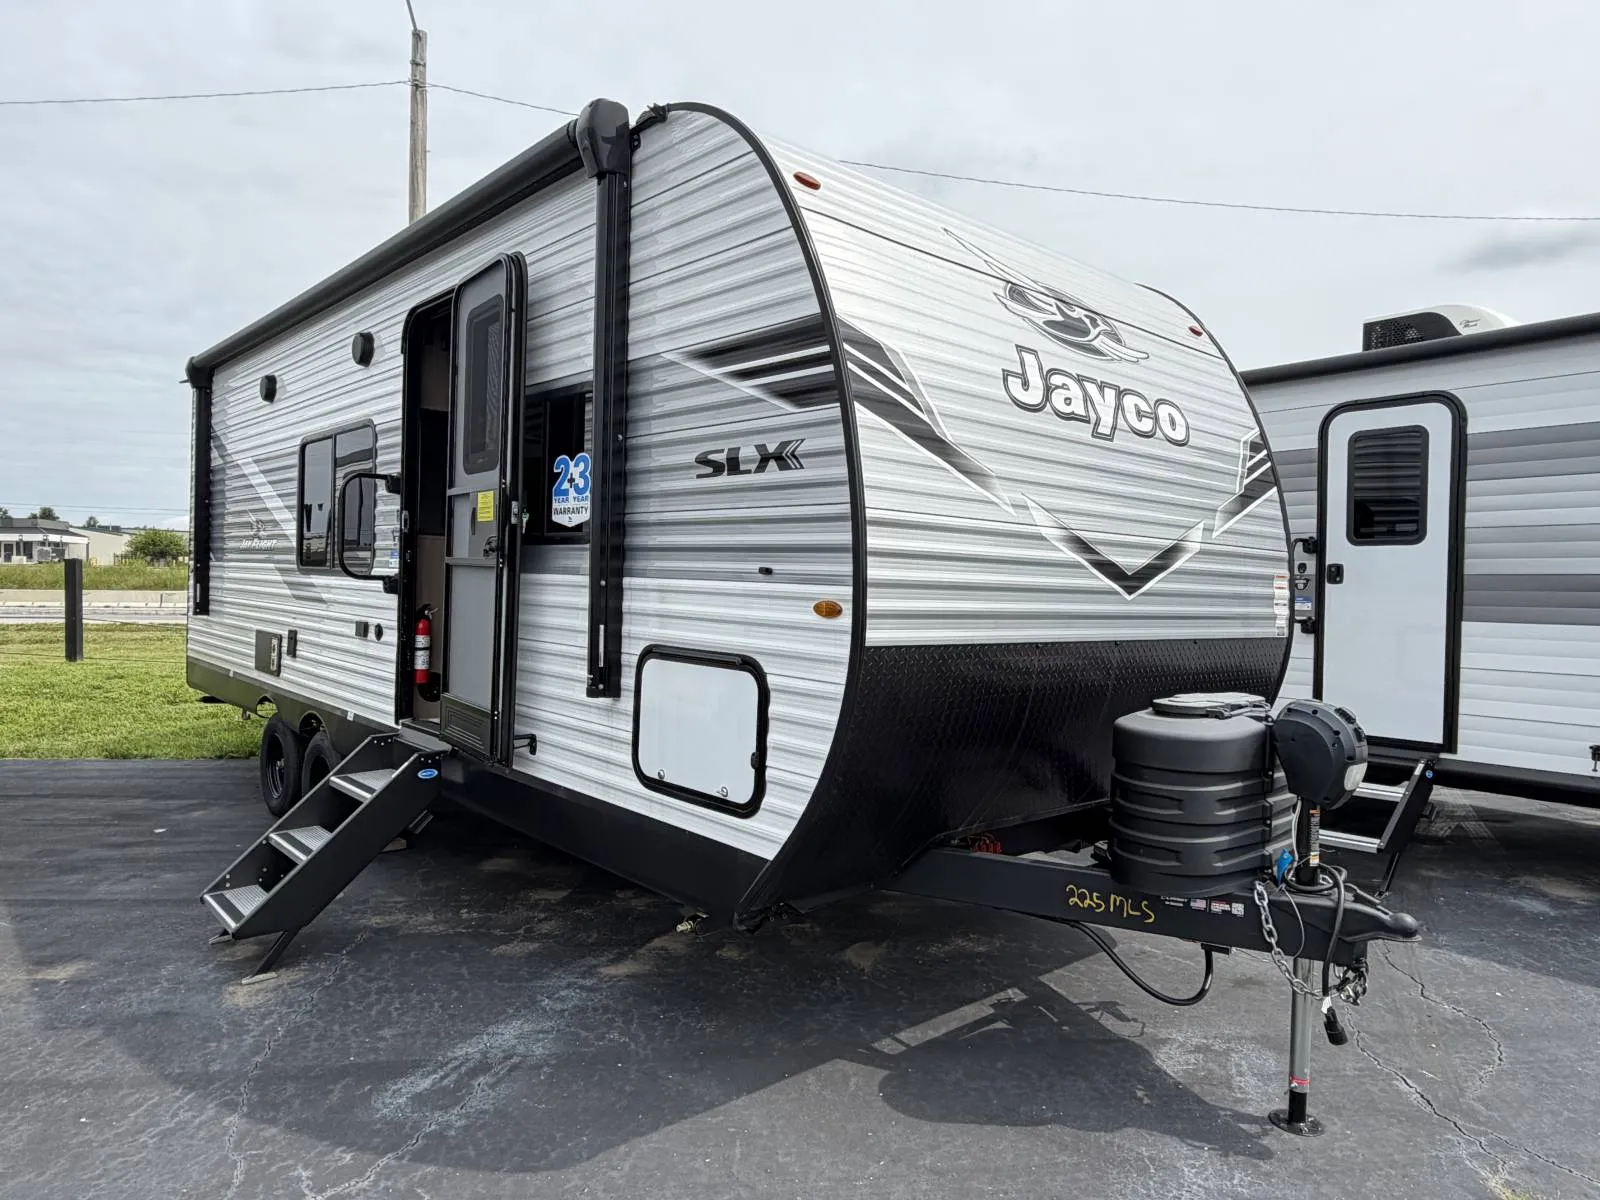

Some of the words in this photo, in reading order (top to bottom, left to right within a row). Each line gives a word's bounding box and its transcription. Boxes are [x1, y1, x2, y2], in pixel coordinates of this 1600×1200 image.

[1001, 344, 1190, 447] Jayco
[694, 438, 806, 479] SLX
[553, 506, 589, 516] WARRANTY
[572, 495, 589, 504] YEAR
[1066, 884, 1106, 913] 225
[1109, 893, 1155, 923] MLS
